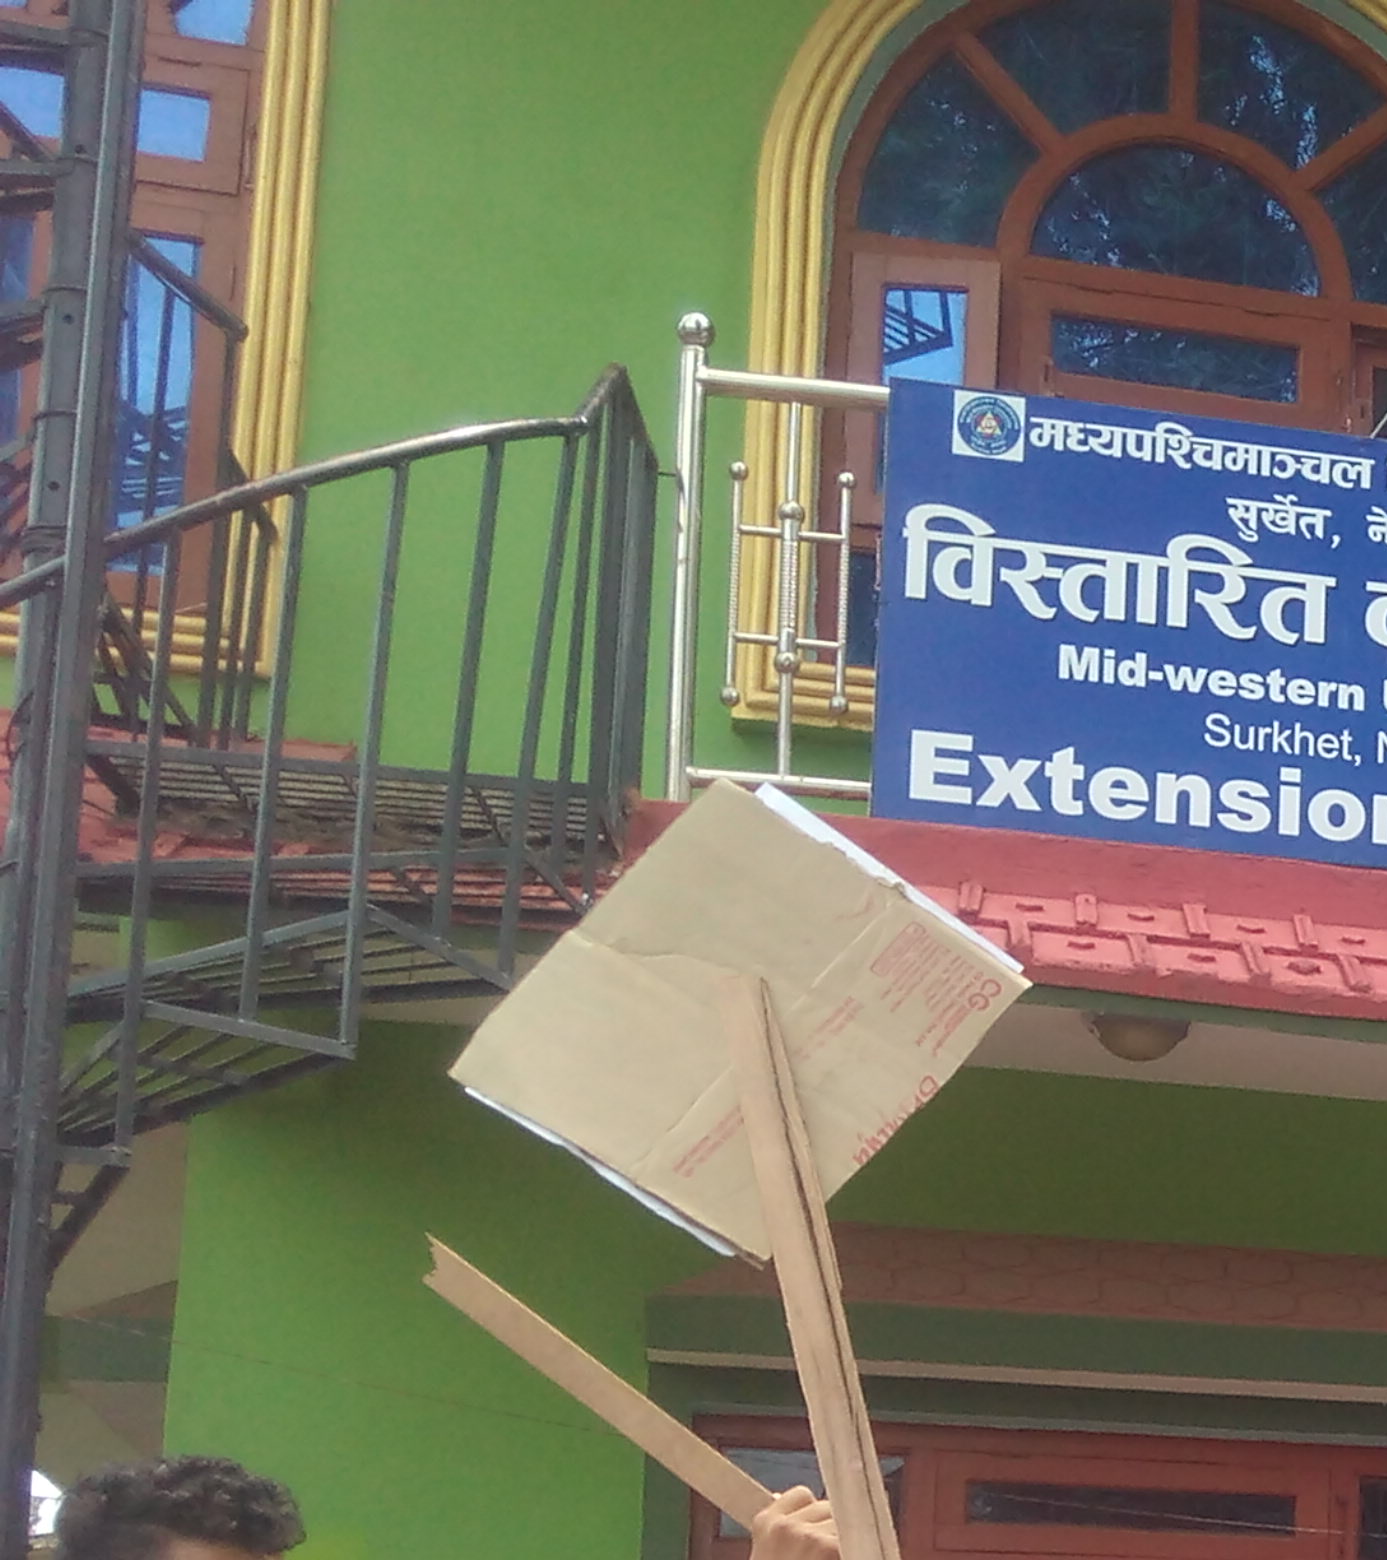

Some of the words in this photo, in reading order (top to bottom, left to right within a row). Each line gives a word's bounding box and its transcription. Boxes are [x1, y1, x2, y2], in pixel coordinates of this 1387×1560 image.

[1028, 416, 1375, 490] मध्यपश्चिमाञ्चल
[1226, 494, 1342, 548] सुर्खेत,
[902, 503, 1336, 646] विस्तारित
[1058, 643, 1365, 711] Mid-western
[1204, 713, 1362, 767] Surkhet,
[969, 979, 1004, 1010] CG
